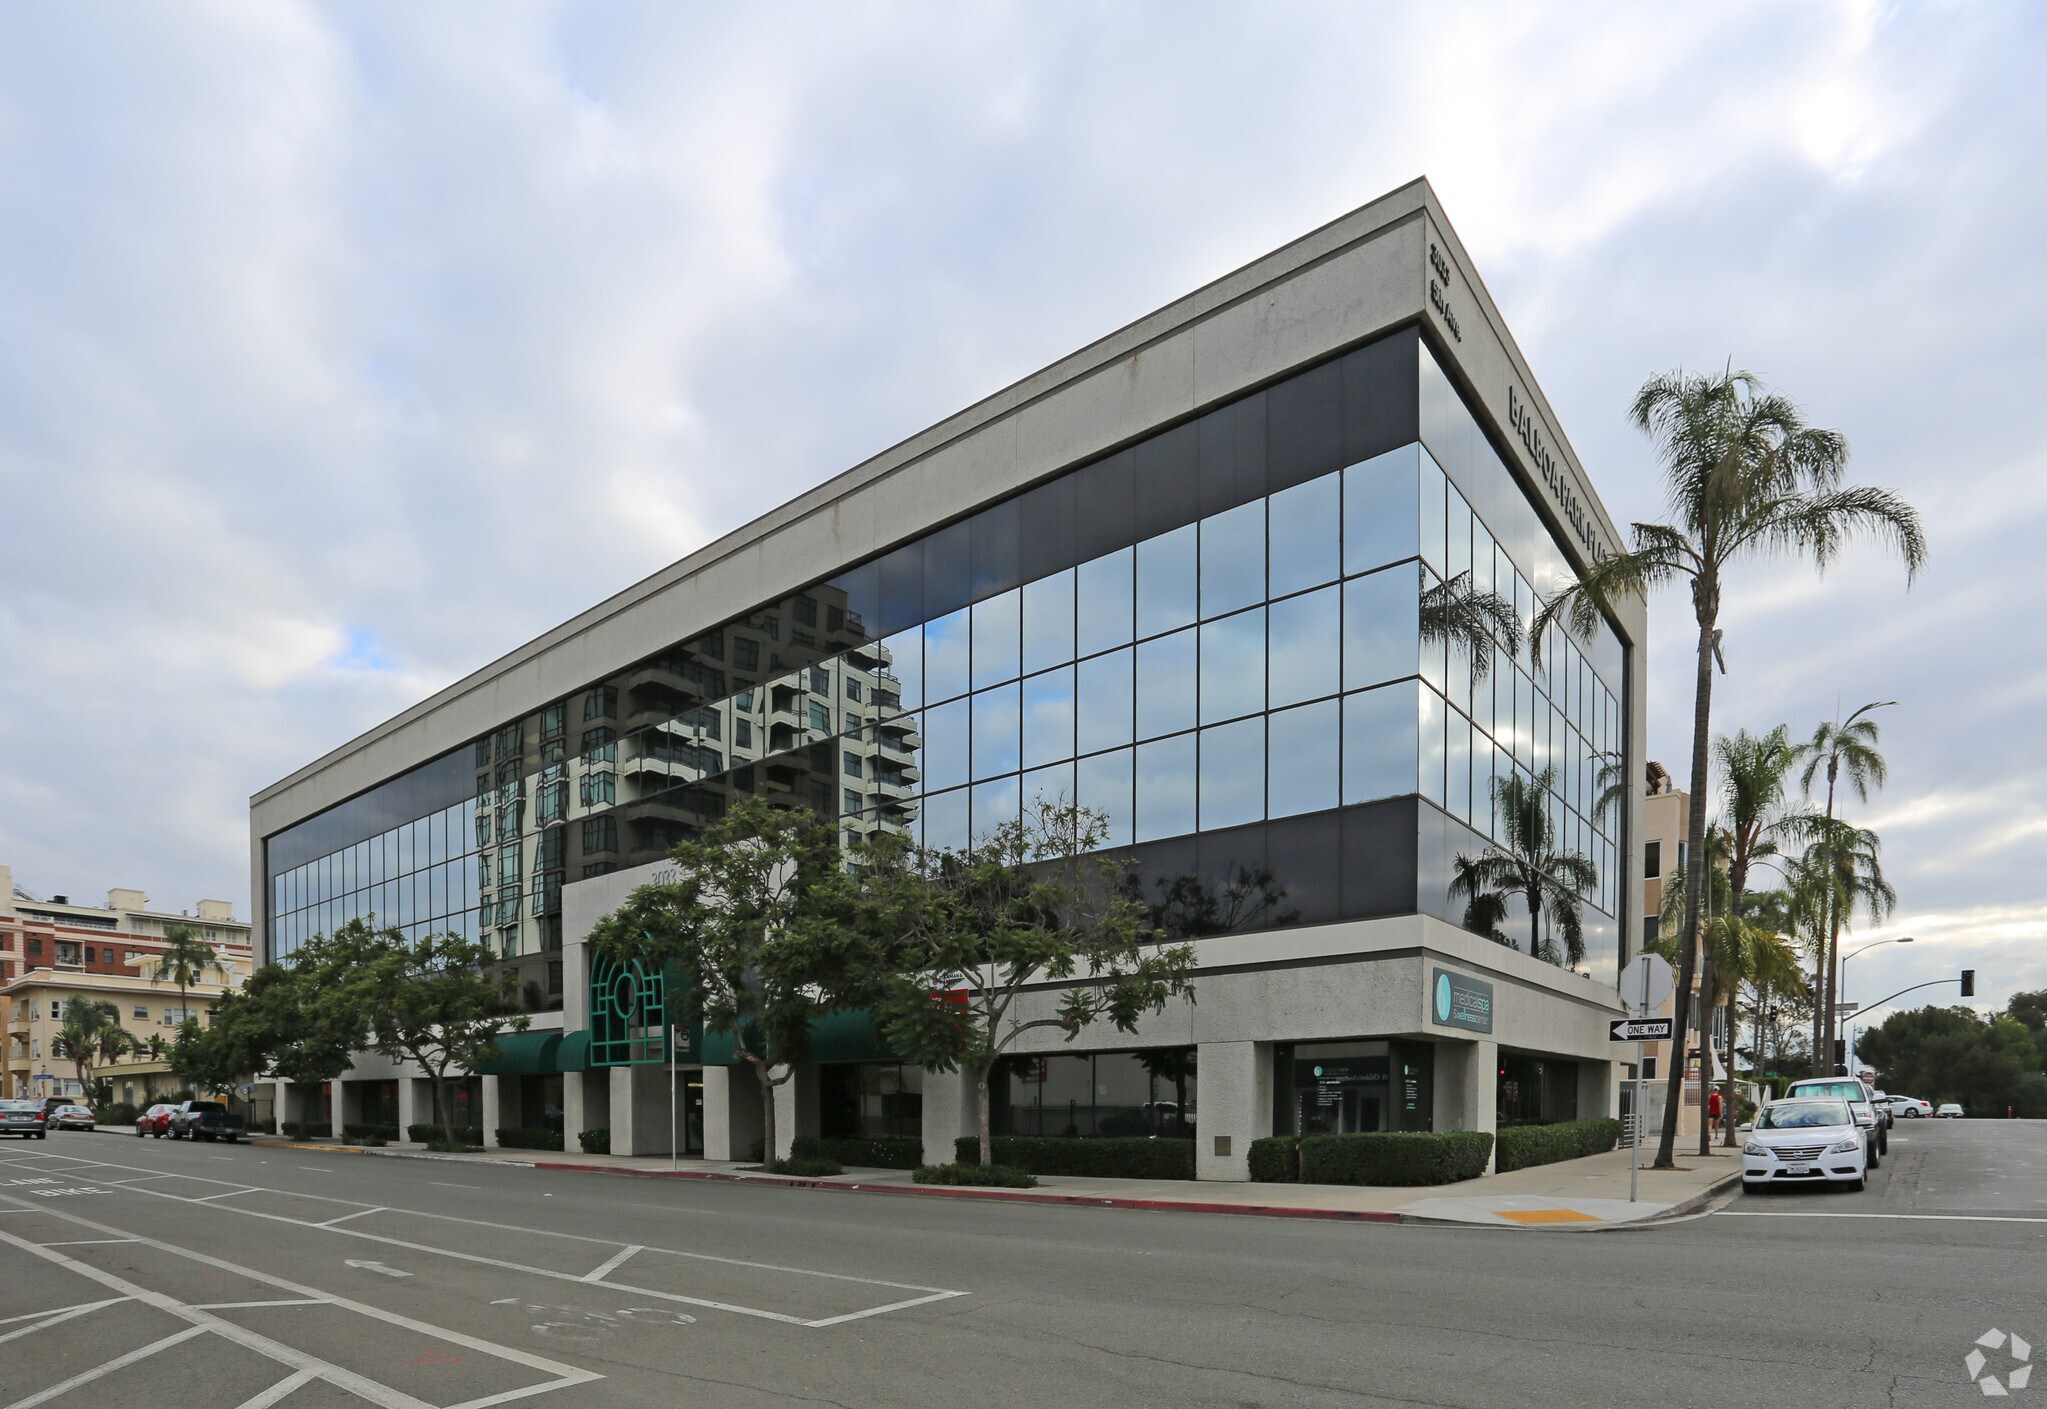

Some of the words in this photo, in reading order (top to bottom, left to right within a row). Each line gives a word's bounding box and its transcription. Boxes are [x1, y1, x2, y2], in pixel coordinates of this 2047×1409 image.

[1509, 385, 1560, 499] BALBOA
[1560, 475, 1587, 544] PARK
[1587, 521, 1607, 563] PLA
[1627, 1025, 1645, 1034] ONE
[1647, 1024, 1666, 1034] WAY
[29, 1187, 114, 1197] BIKE
